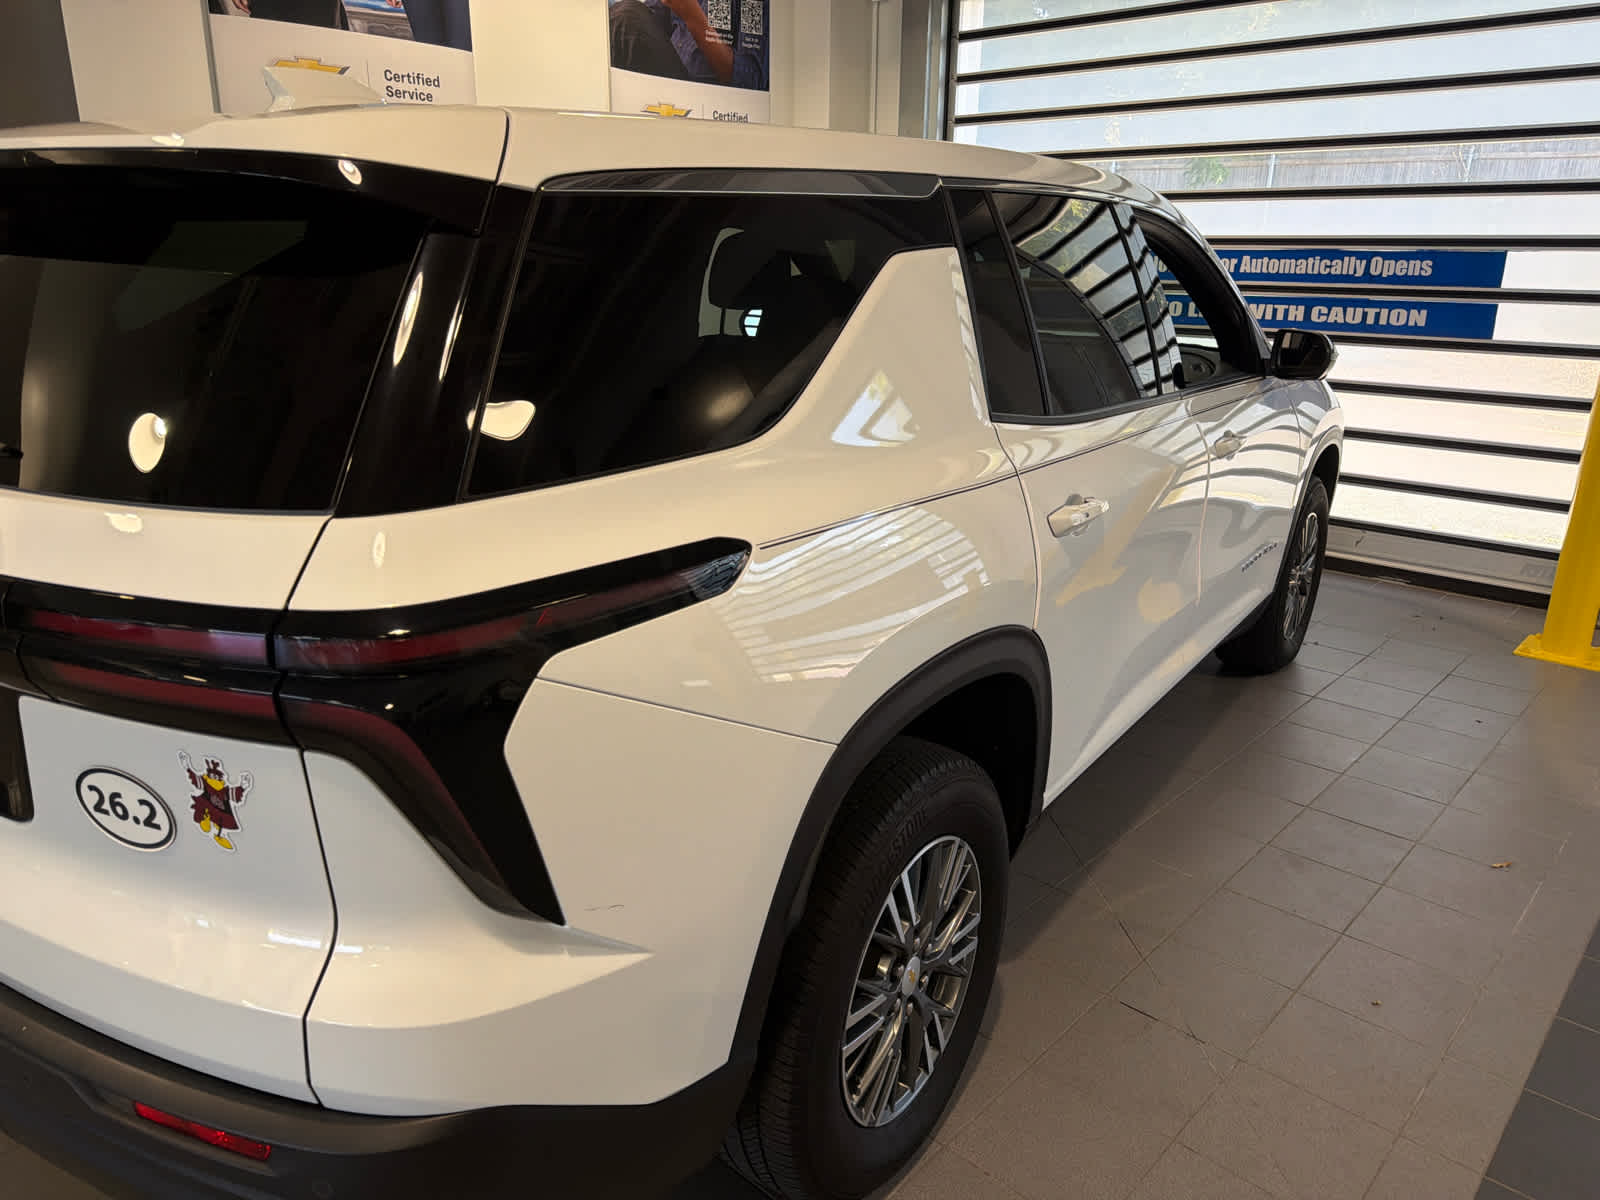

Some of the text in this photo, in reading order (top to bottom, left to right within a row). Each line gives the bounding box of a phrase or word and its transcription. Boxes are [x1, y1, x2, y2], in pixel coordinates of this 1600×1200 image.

[384, 69, 440, 88] Certified
[386, 86, 433, 102] Service
[712, 110, 748, 123] Certified
[1239, 255, 1367, 277] Automatically
[1369, 256, 1433, 278] Opens
[1310, 305, 1428, 327] CAUTION
[87, 784, 161, 831] 26.2
